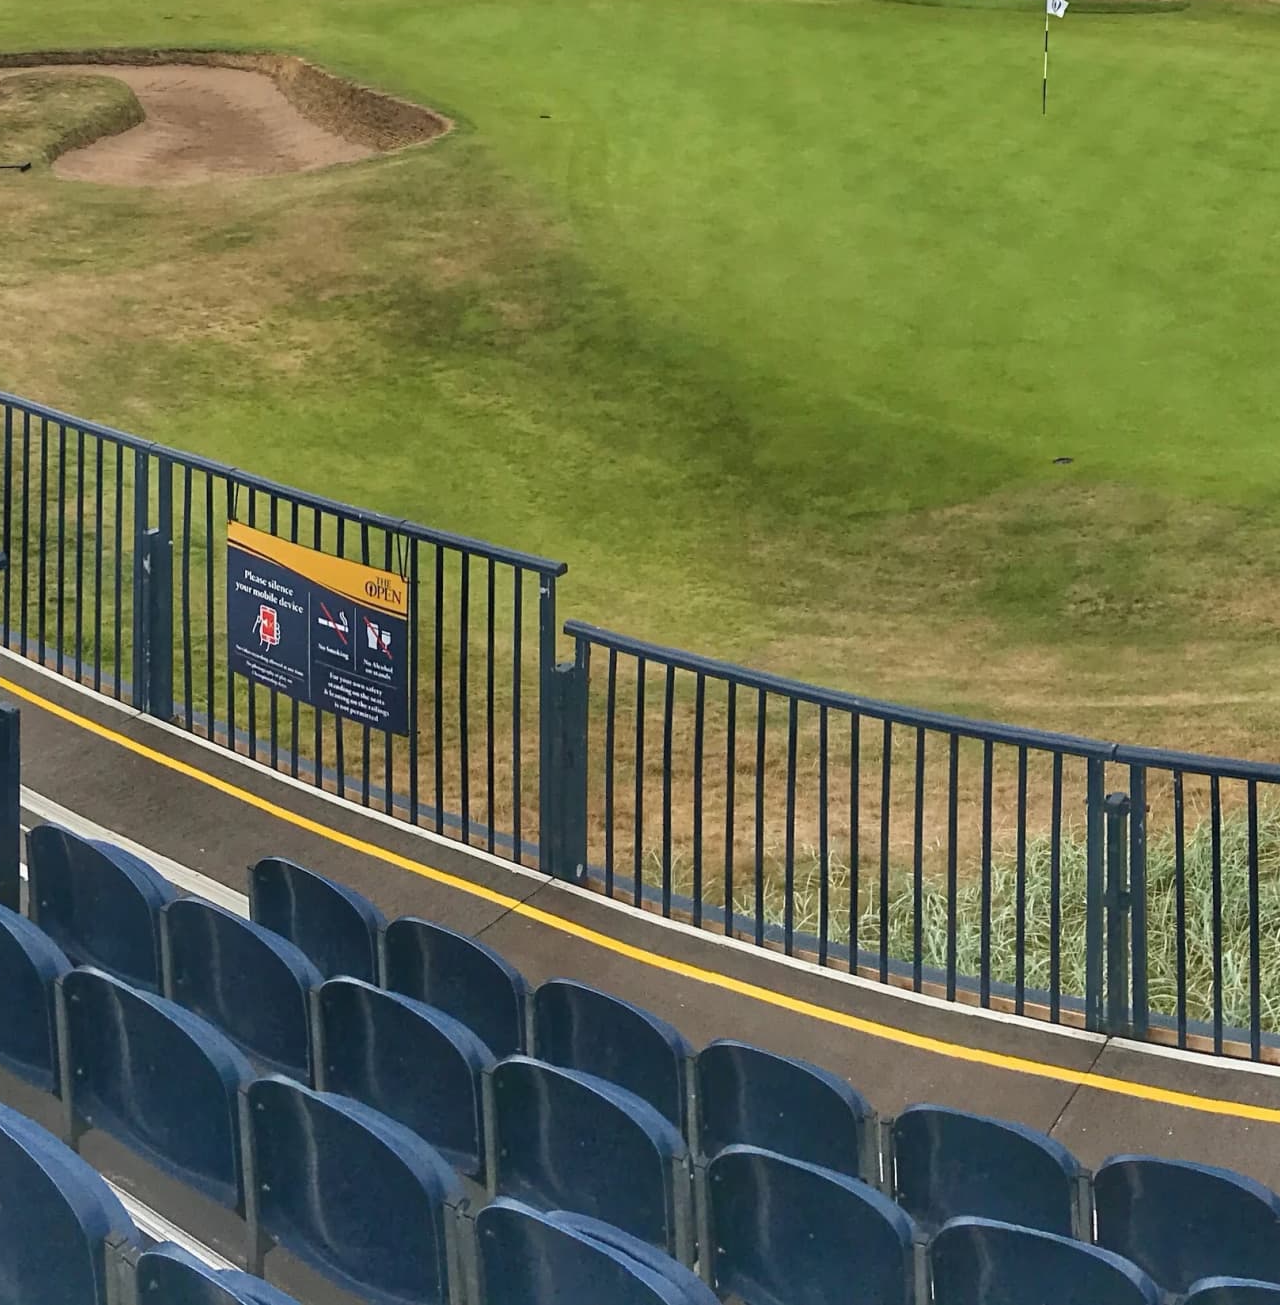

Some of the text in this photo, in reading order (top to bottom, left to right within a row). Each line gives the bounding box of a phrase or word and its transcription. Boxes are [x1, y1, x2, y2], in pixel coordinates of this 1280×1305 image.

[244, 569, 294, 596] Please silence
[365, 581, 401, 604] OPEN
[376, 576, 391, 588] THE
[235, 582, 304, 613] your mobile device
